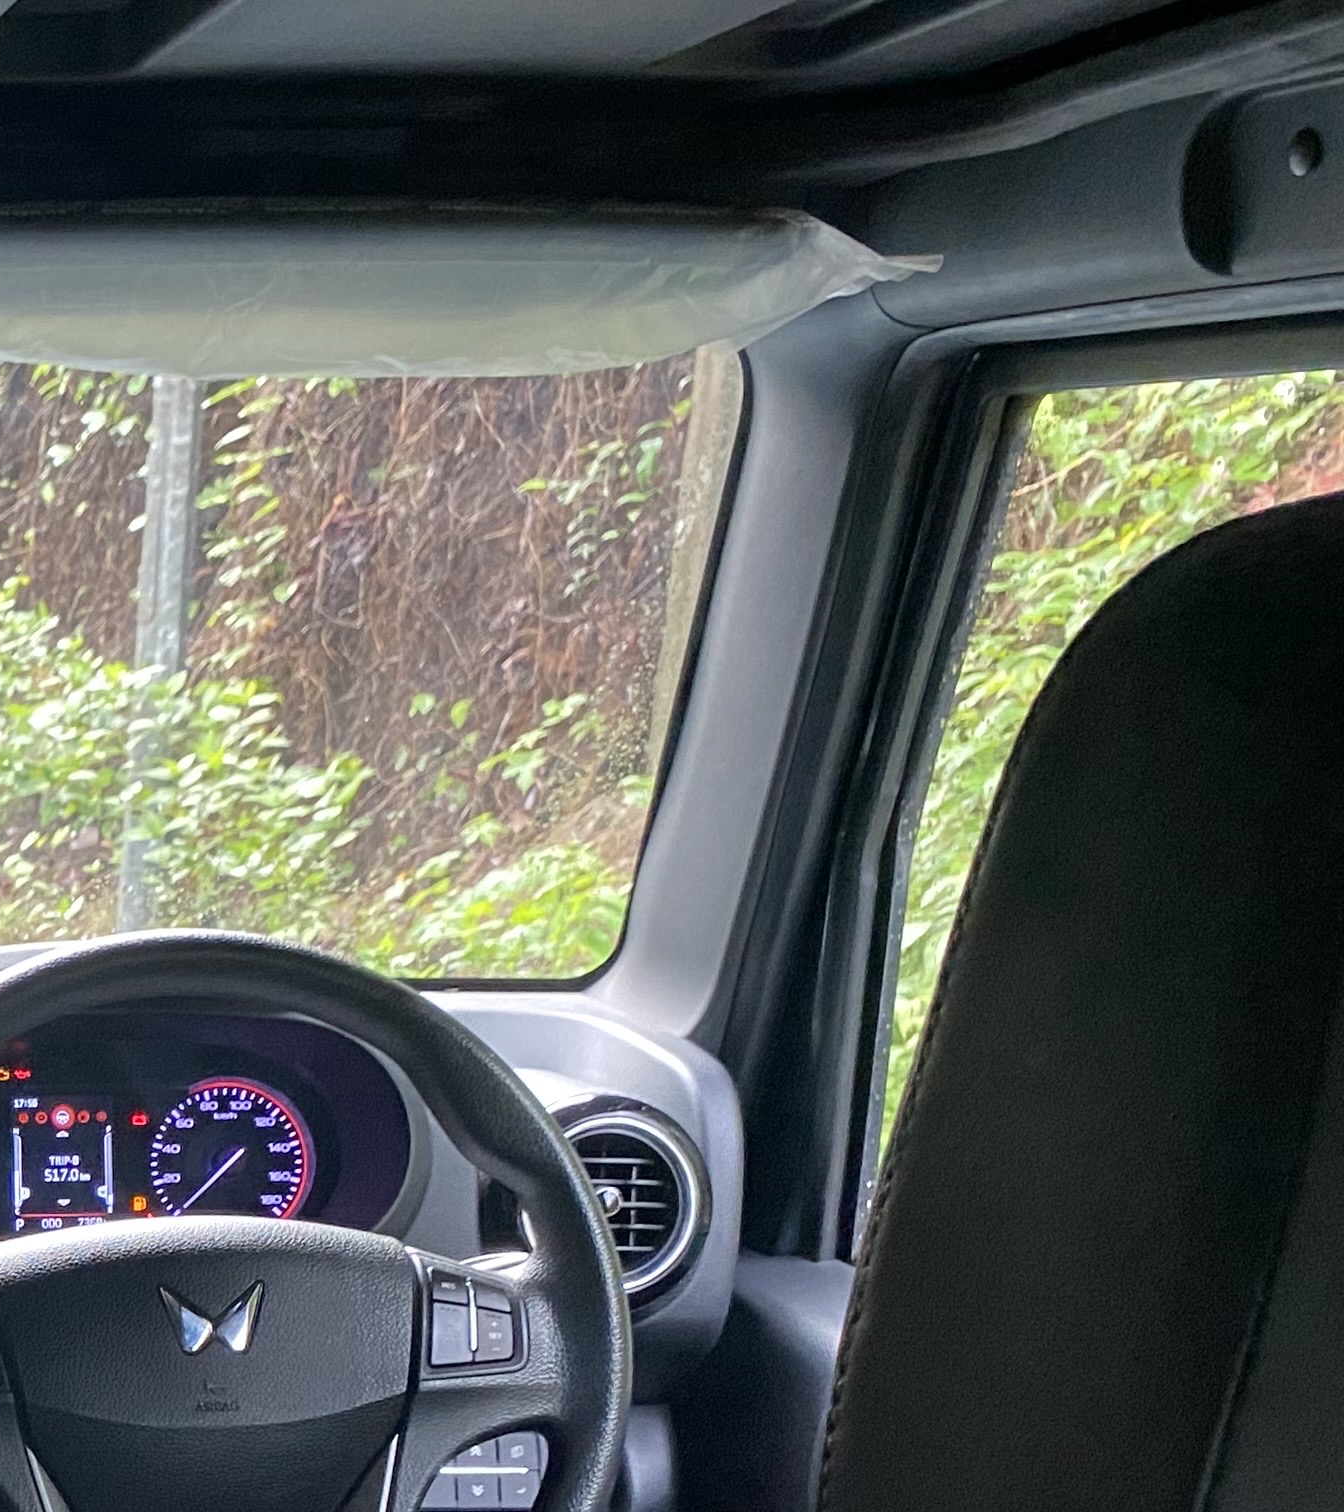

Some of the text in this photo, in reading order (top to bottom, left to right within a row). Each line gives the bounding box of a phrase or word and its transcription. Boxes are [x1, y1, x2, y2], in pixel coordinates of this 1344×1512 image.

[229, 1101, 252, 1111] 100
[254, 1117, 276, 1127] 120
[163, 1144, 181, 1154] 40
[268, 1143, 291, 1153] 140
[44, 1168, 79, 1182] 517.0
